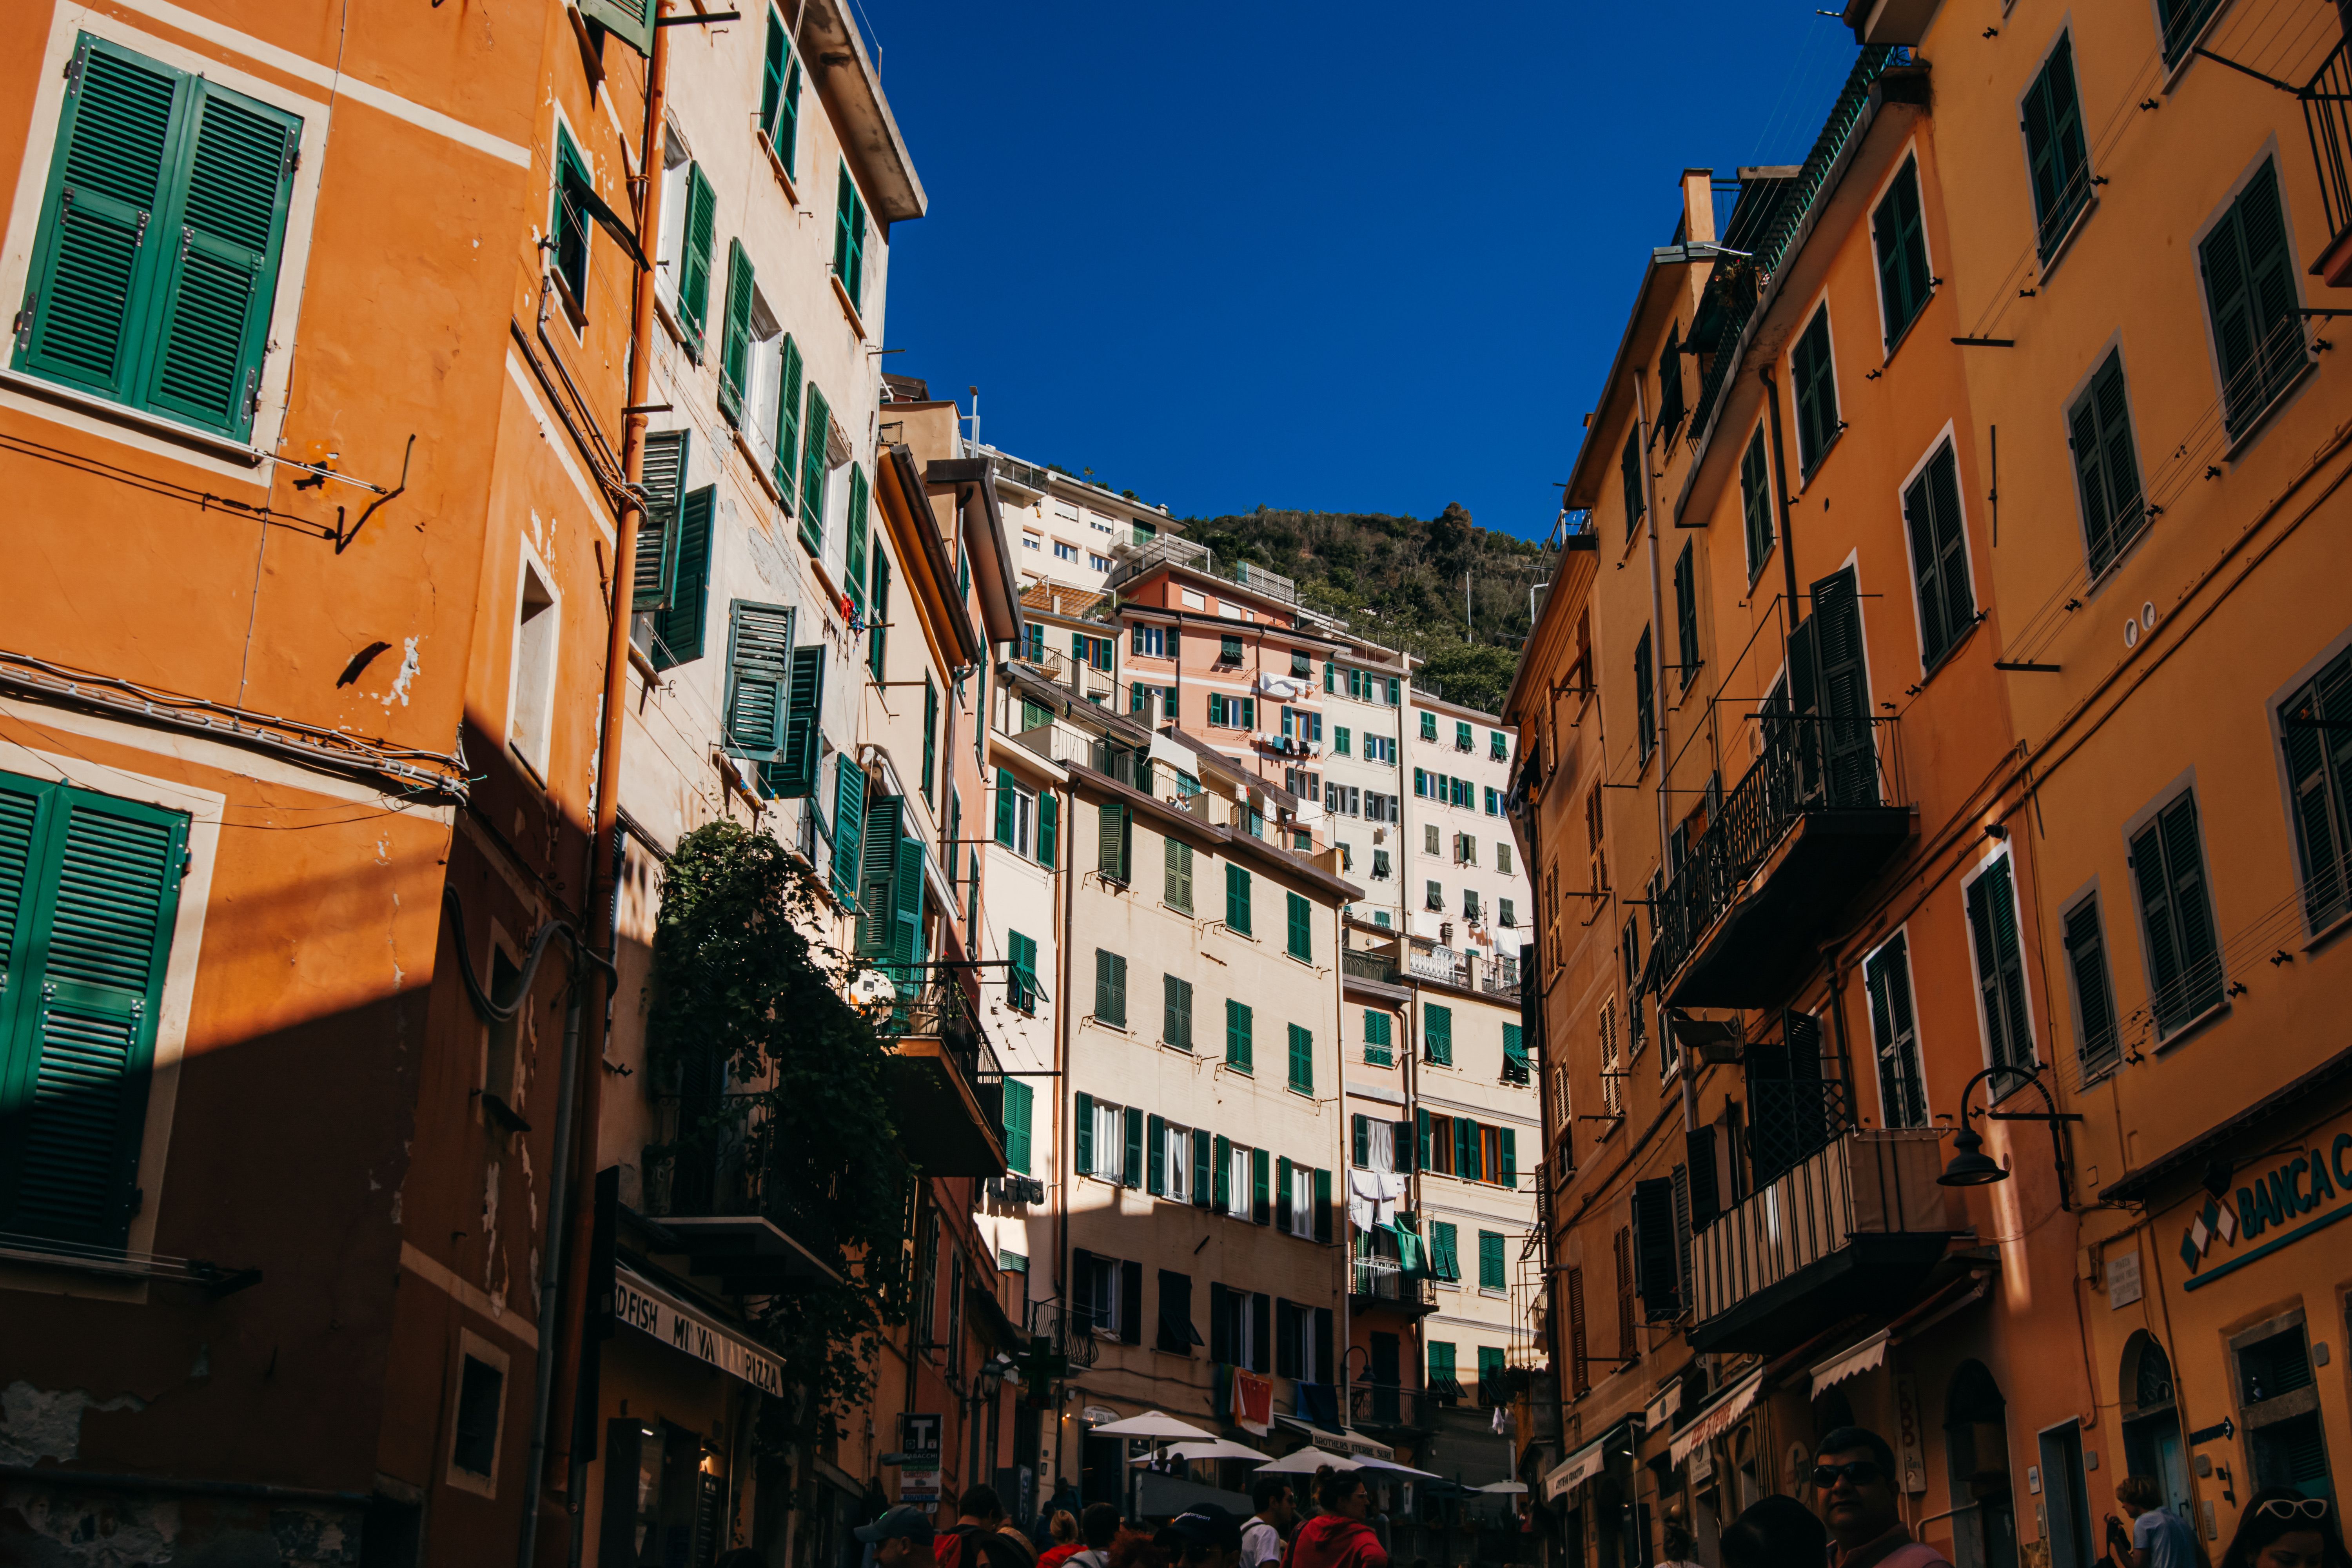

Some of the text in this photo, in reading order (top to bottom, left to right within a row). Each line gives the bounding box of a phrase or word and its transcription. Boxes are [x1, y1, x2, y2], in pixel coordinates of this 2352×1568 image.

[2236, 1149, 2335, 1239] BANCA
[628, 1292, 657, 1334] FISH
[673, 1315, 689, 1350] MI
[746, 1353, 777, 1394] PIZZA
[911, 1420, 933, 1449] T
[1315, 1436, 1348, 1450] BROTHERS
[1377, 1450, 1392, 1459] SURF
